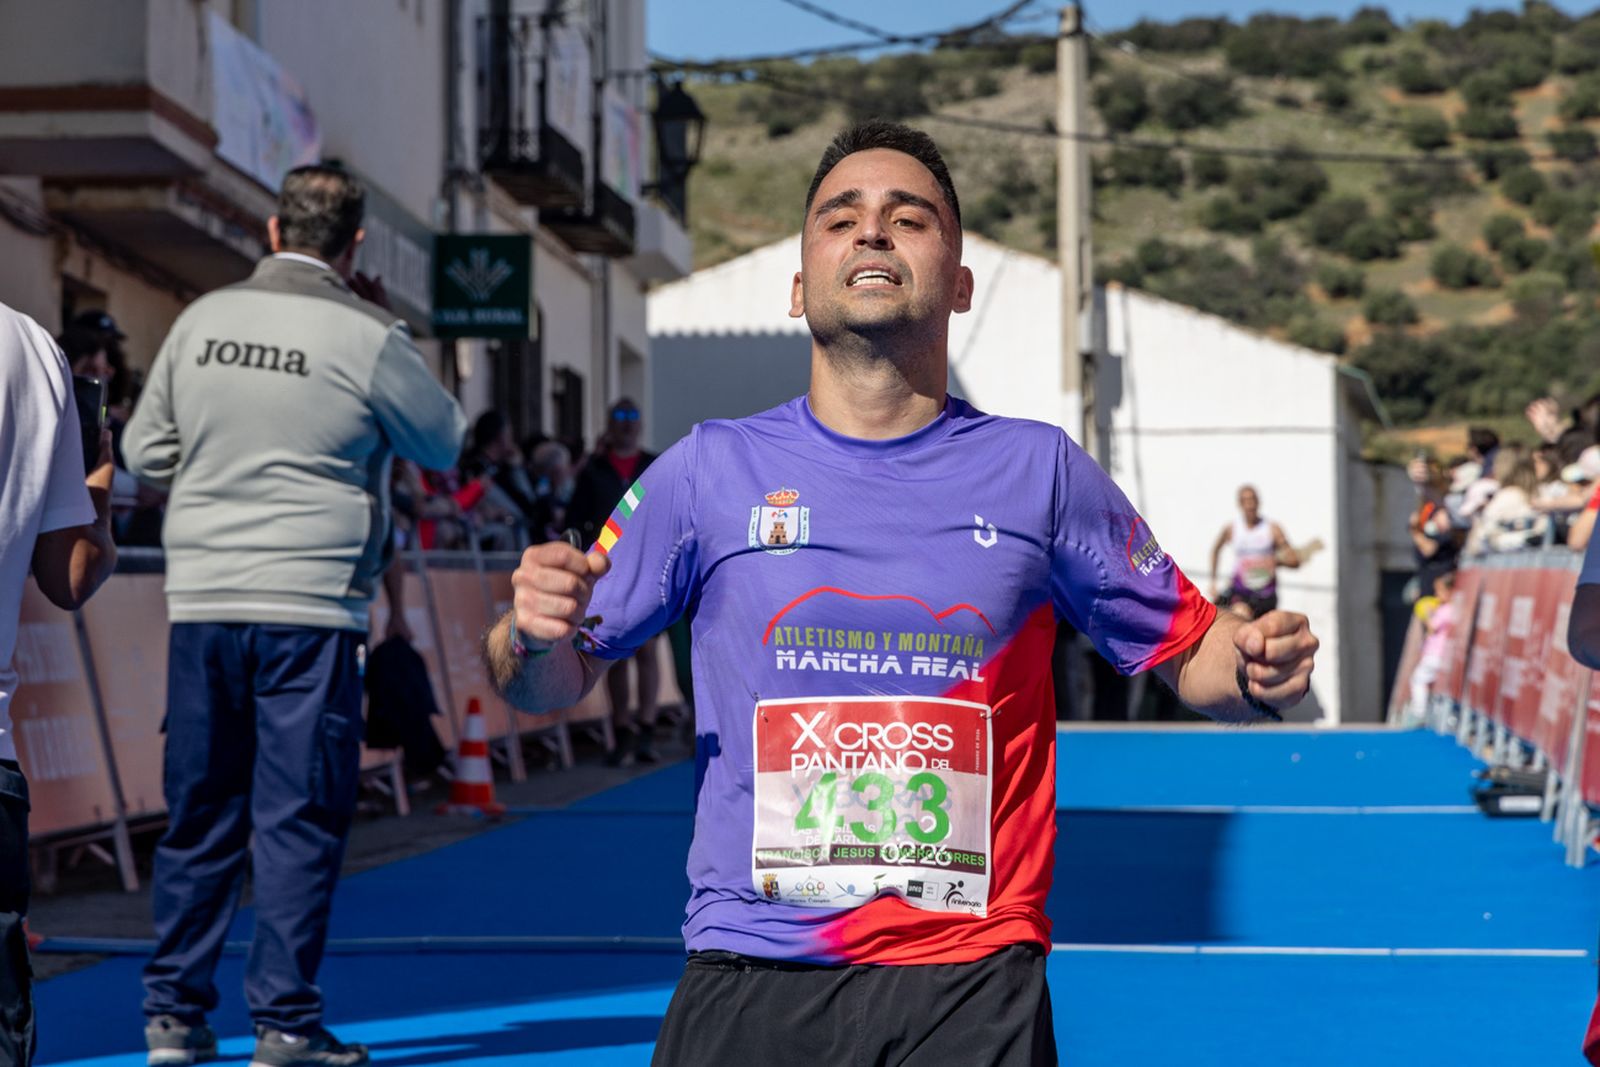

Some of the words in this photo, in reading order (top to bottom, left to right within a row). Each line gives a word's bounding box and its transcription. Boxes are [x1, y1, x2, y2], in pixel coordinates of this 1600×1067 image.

[196, 338, 310, 378] Joma
[774, 626, 875, 651] ATLETISMO
[883, 632, 892, 651] Y
[900, 632, 984, 658] MONTAÑA
[776, 649, 903, 675] MANCHA
[911, 656, 985, 683] REAL
[790, 711, 827, 751] X
[834, 721, 954, 752] CROSS
[790, 750, 927, 779] PANTANO
[931, 757, 953, 772] DEL
[794, 772, 949, 844] 433
[833, 847, 876, 859] JESUS
